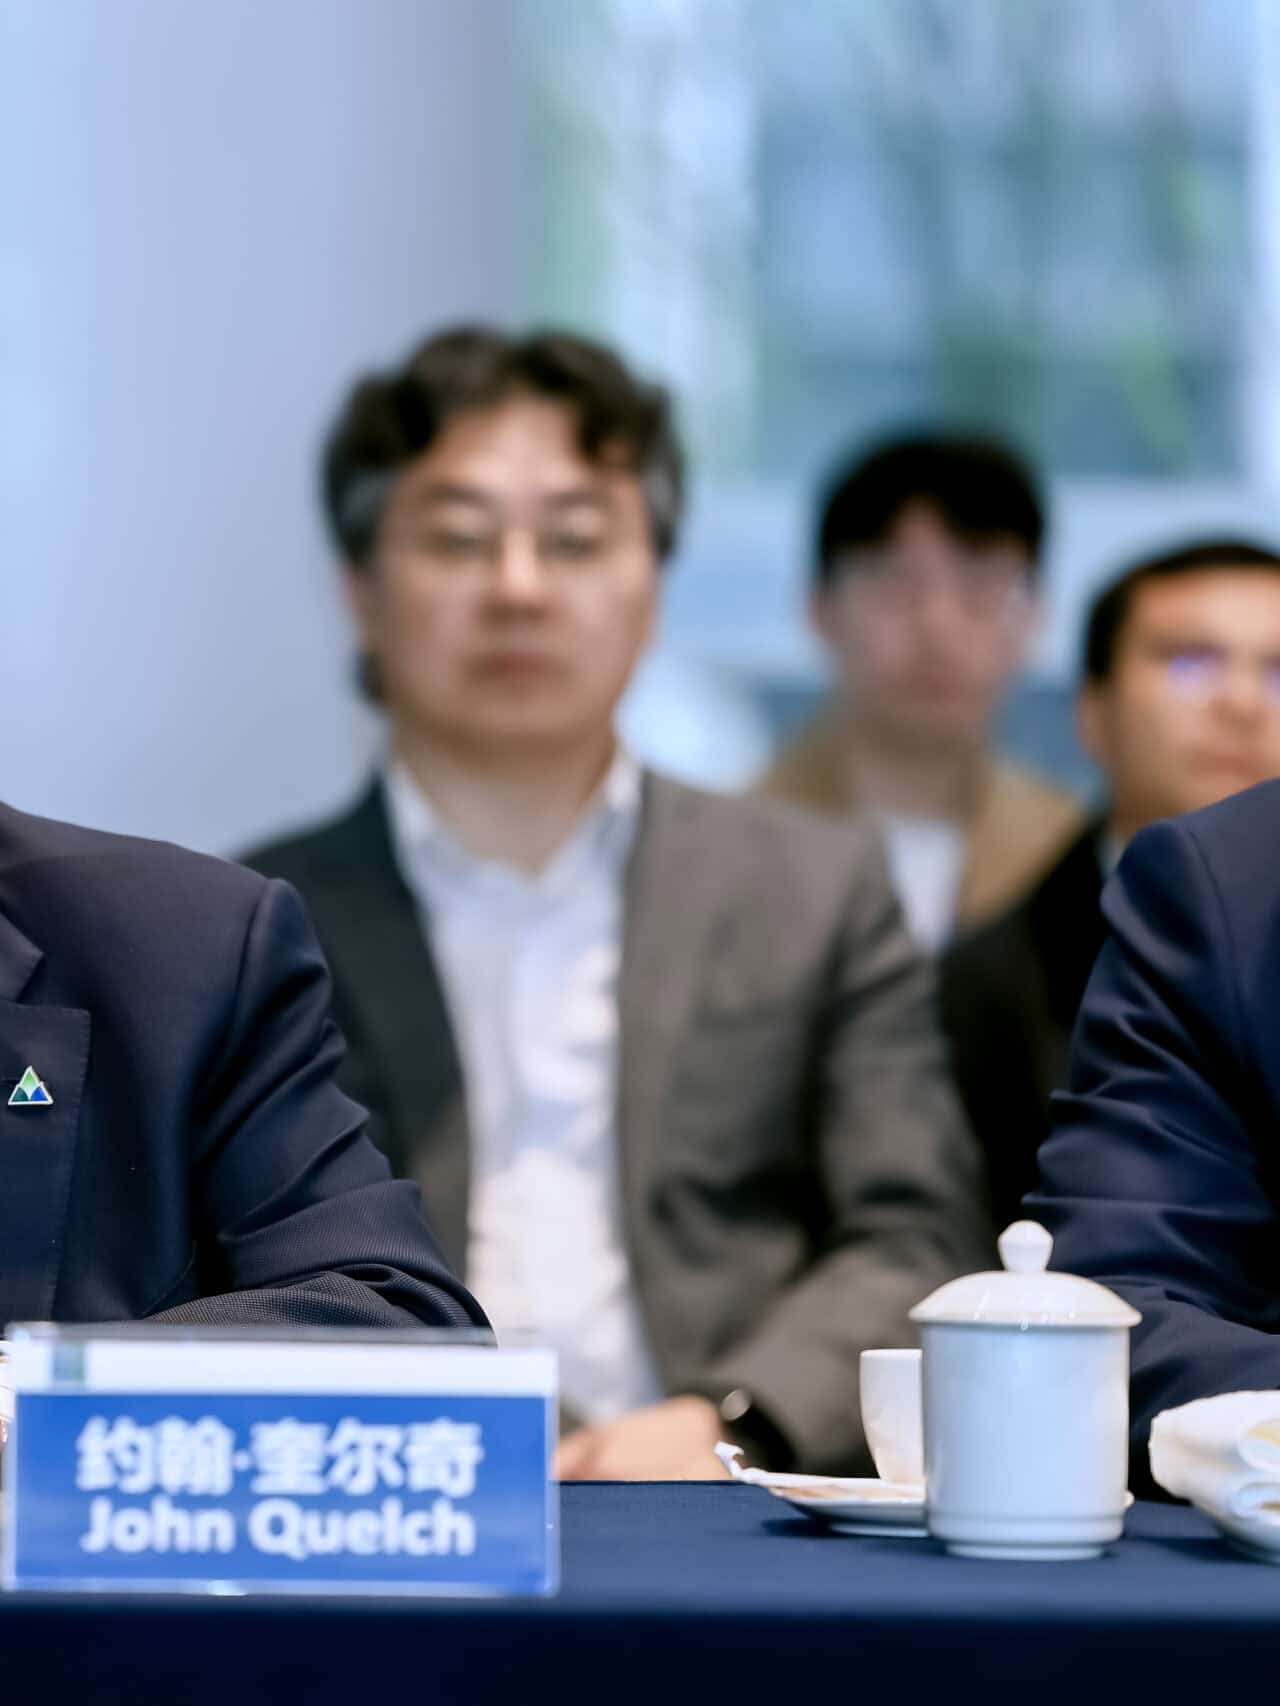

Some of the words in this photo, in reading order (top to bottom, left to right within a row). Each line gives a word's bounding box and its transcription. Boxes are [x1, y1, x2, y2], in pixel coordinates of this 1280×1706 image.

[77, 1416, 483, 1496] 约翰·奎尔奇
[81, 1498, 235, 1554] John
[249, 1498, 475, 1558] Quelch
